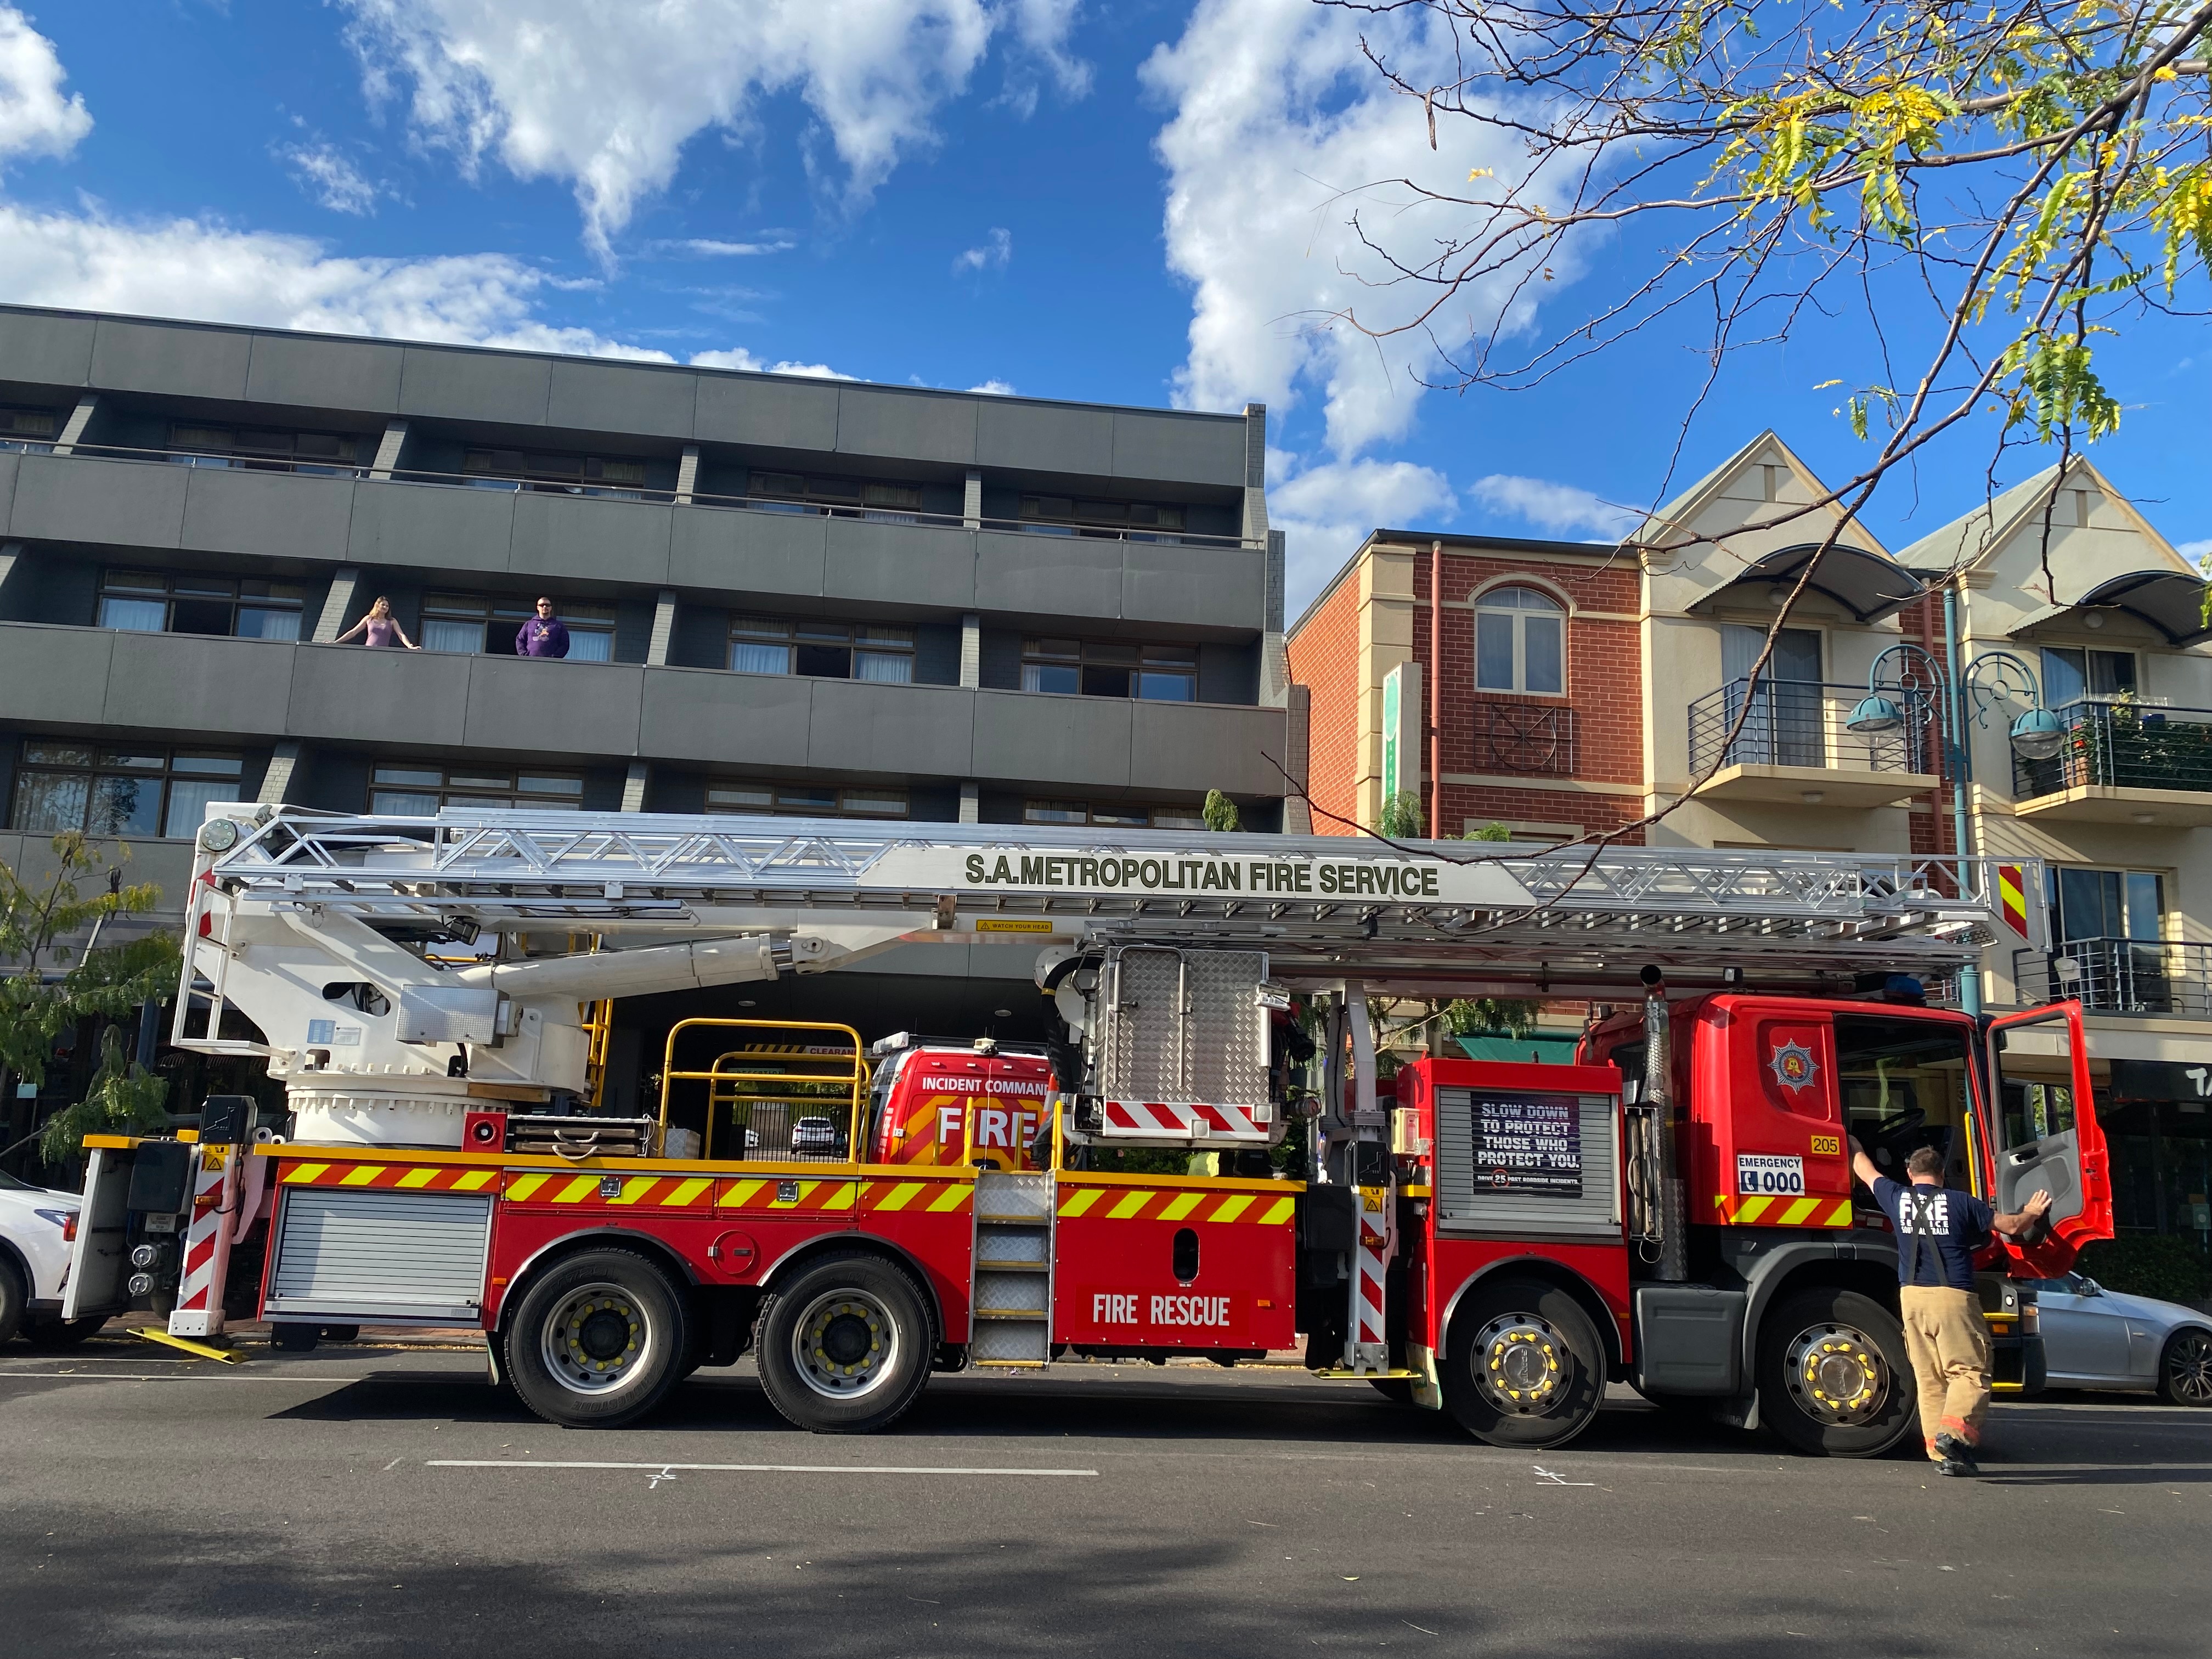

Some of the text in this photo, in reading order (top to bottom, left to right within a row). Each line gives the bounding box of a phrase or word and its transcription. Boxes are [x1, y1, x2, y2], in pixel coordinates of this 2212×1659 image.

[1250, 862, 1312, 893] FIRE
[1319, 864, 1440, 896] SERVICE
[922, 1077, 982, 1092] INCIDENT
[1481, 1103, 1569, 1120] SLOW DOWN
[1481, 1119, 1571, 1136] TO PROTECT
[1483, 1136, 1568, 1152] THOSE WHO
[1813, 1138, 1838, 1153] 205
[1477, 1151, 1580, 1168] PROTECT YOU.
[1739, 1157, 1801, 1169] EMERGENCY
[1495, 1175, 1506, 1183] 25
[1763, 1171, 1802, 1193] 000
[1900, 1219, 1949, 1228] SEICE
[1093, 1294, 1231, 1327] FIRE RESCUE
